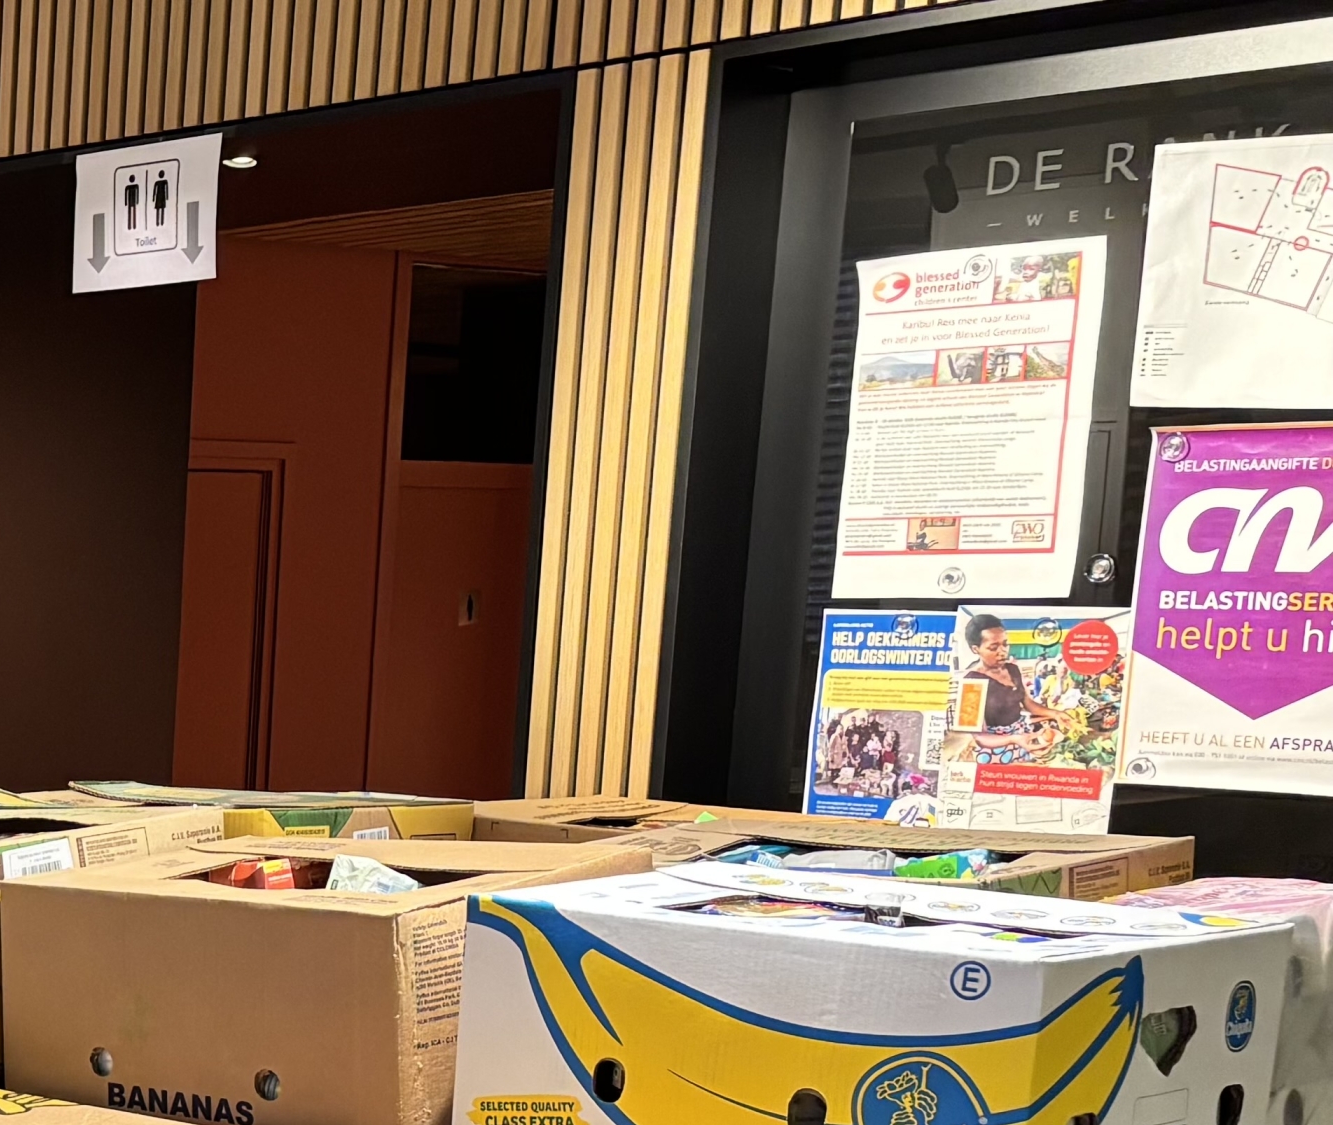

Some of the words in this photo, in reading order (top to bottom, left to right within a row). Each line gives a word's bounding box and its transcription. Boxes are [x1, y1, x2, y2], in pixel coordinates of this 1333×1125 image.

[986, 148, 1065, 196] DE
[135, 237, 157, 248] Toilet
[915, 269, 960, 284] blessed
[915, 281, 979, 298] generation
[1174, 457, 1319, 473] BELASTINGAANGIFTE
[832, 631, 864, 647] HELP
[1156, 617, 1253, 660] helpt
[1266, 628, 1288, 652] u
[831, 649, 933, 666] OORLOGSWINTER
[1139, 731, 1190, 745] HEEFT
[1194, 733, 1204, 746] U
[1208, 734, 1228, 747] AL
[1233, 735, 1265, 749] EEN
[961, 967, 981, 994] E
[480, 1101, 528, 1114] SELECTED
[531, 1101, 575, 1115] QUALITY
